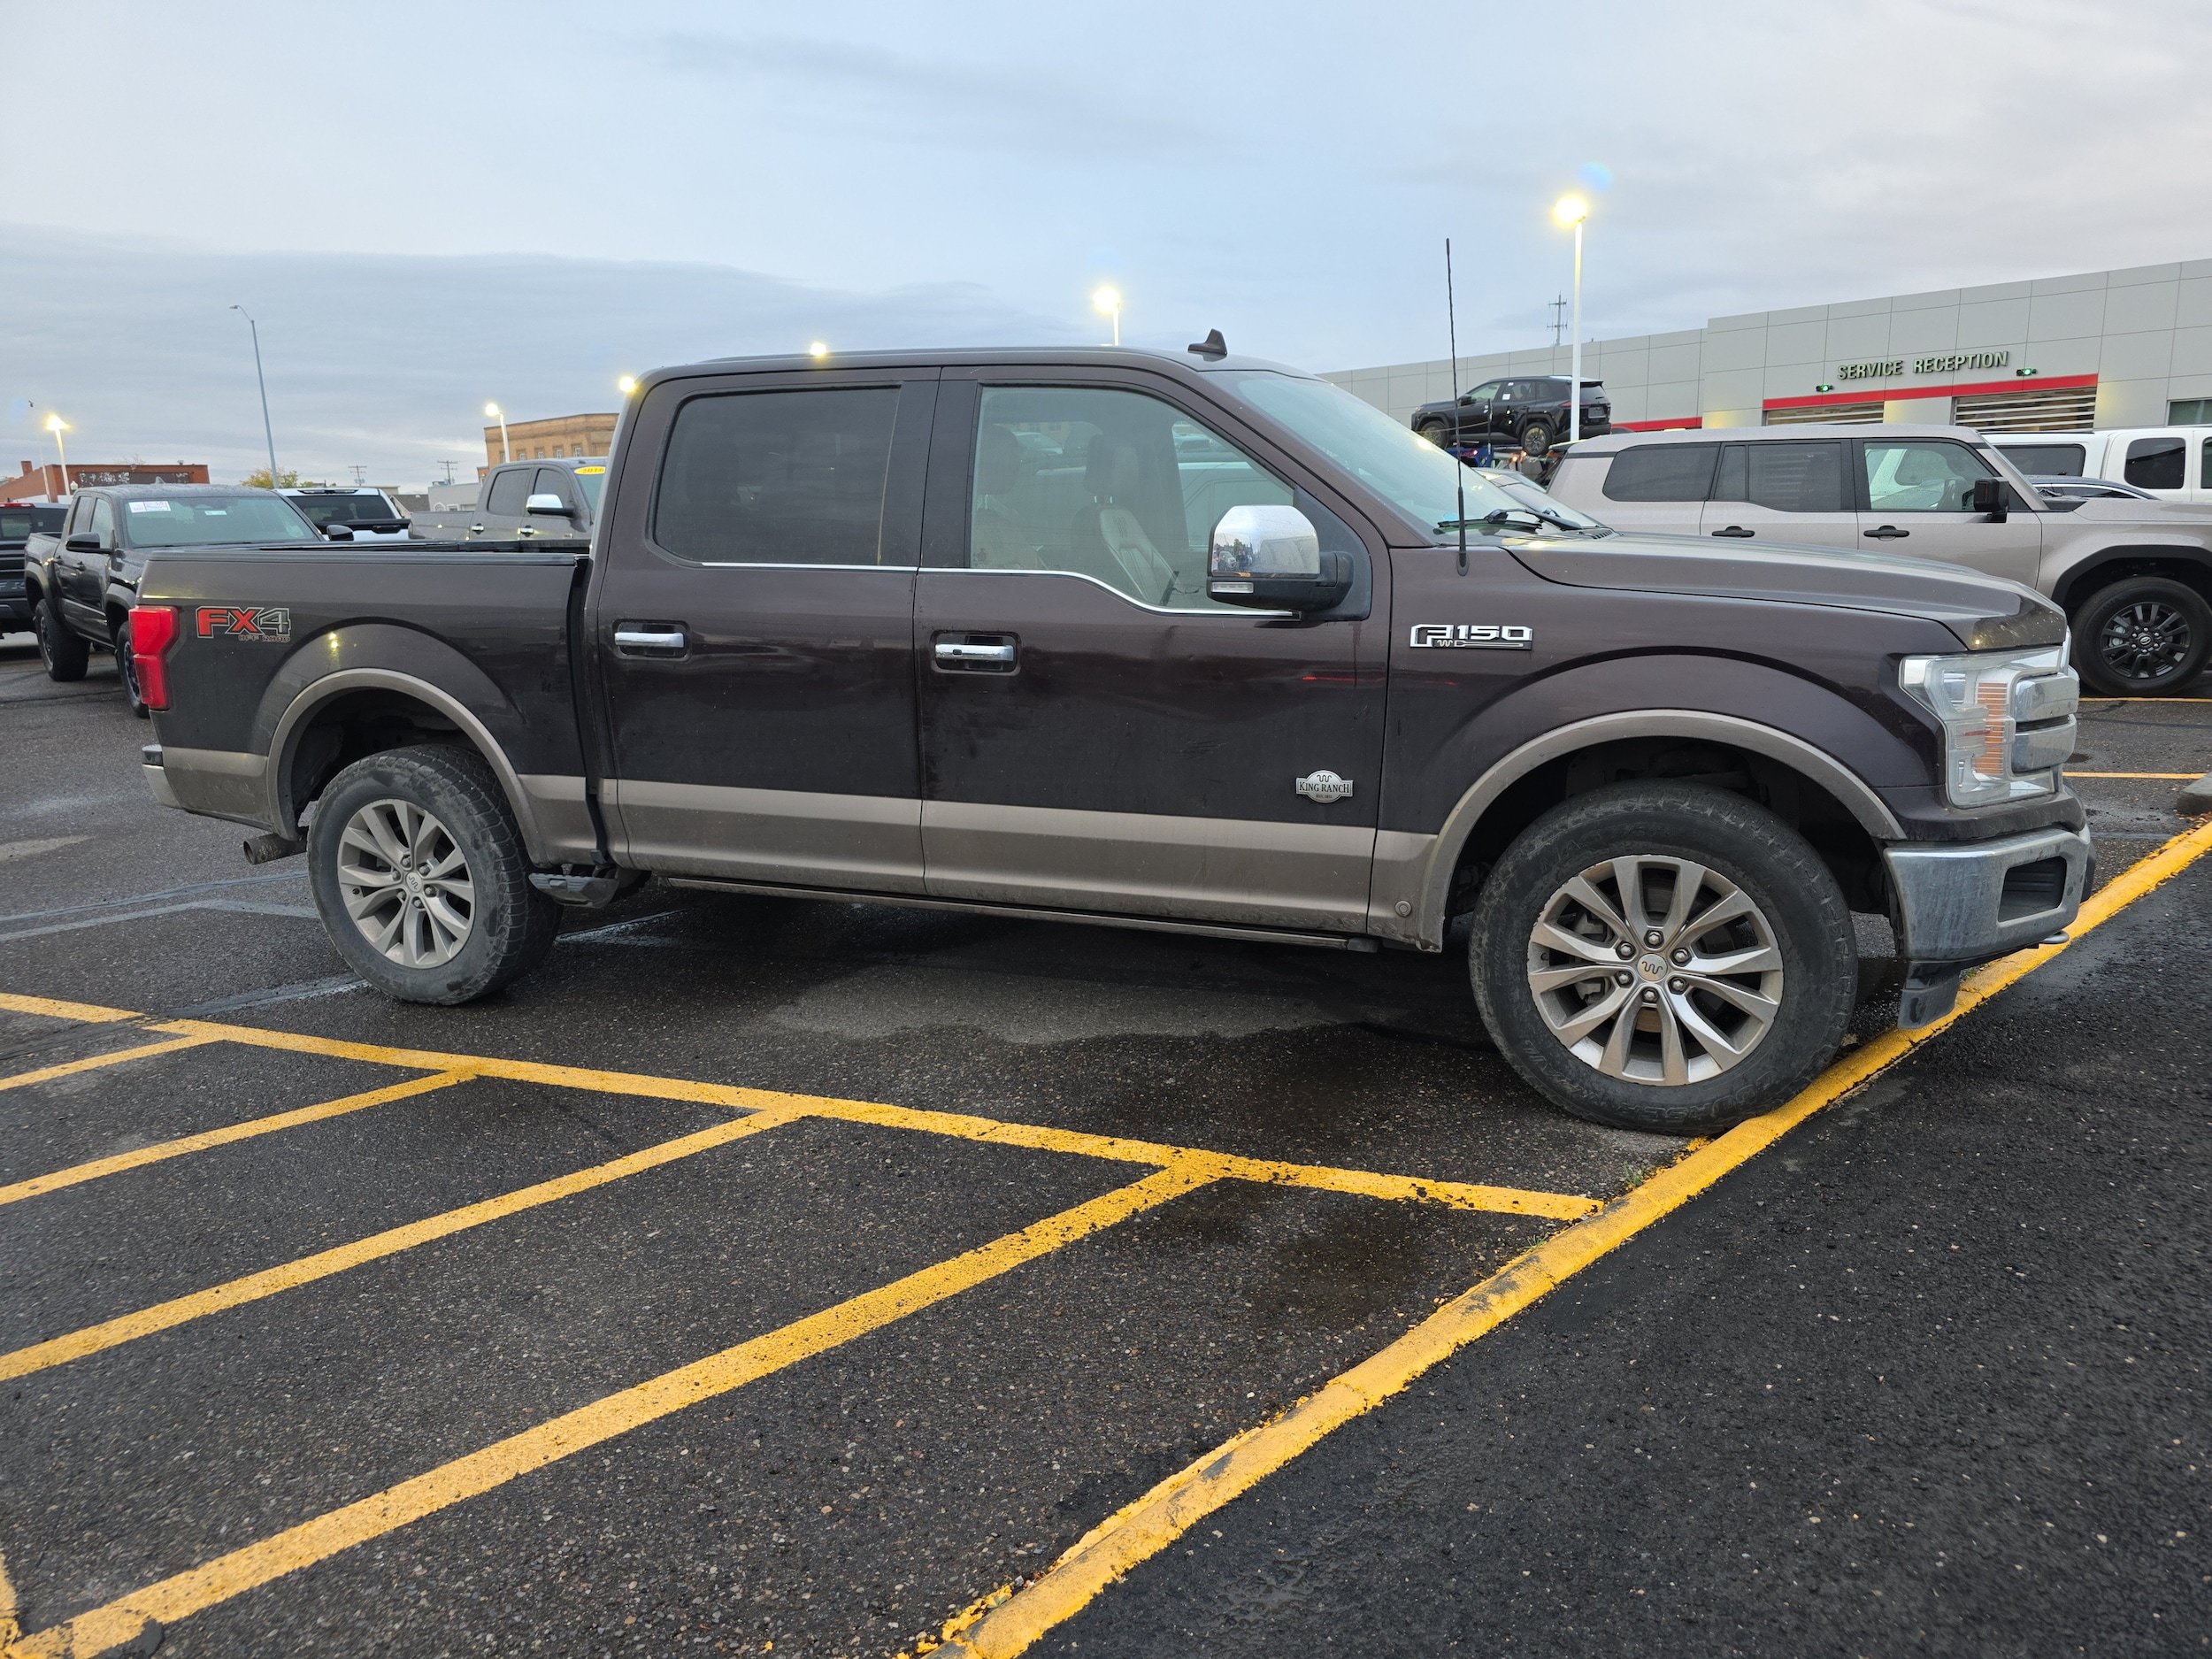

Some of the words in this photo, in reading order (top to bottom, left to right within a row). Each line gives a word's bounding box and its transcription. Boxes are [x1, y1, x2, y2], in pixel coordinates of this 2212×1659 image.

[1837, 359, 1904, 380] SERVICE
[1912, 350, 2009, 375] RECEPTION
[196, 605, 292, 639] FX4
[1299, 781, 1319, 792] KING
[1321, 783, 1349, 794] RANCH
